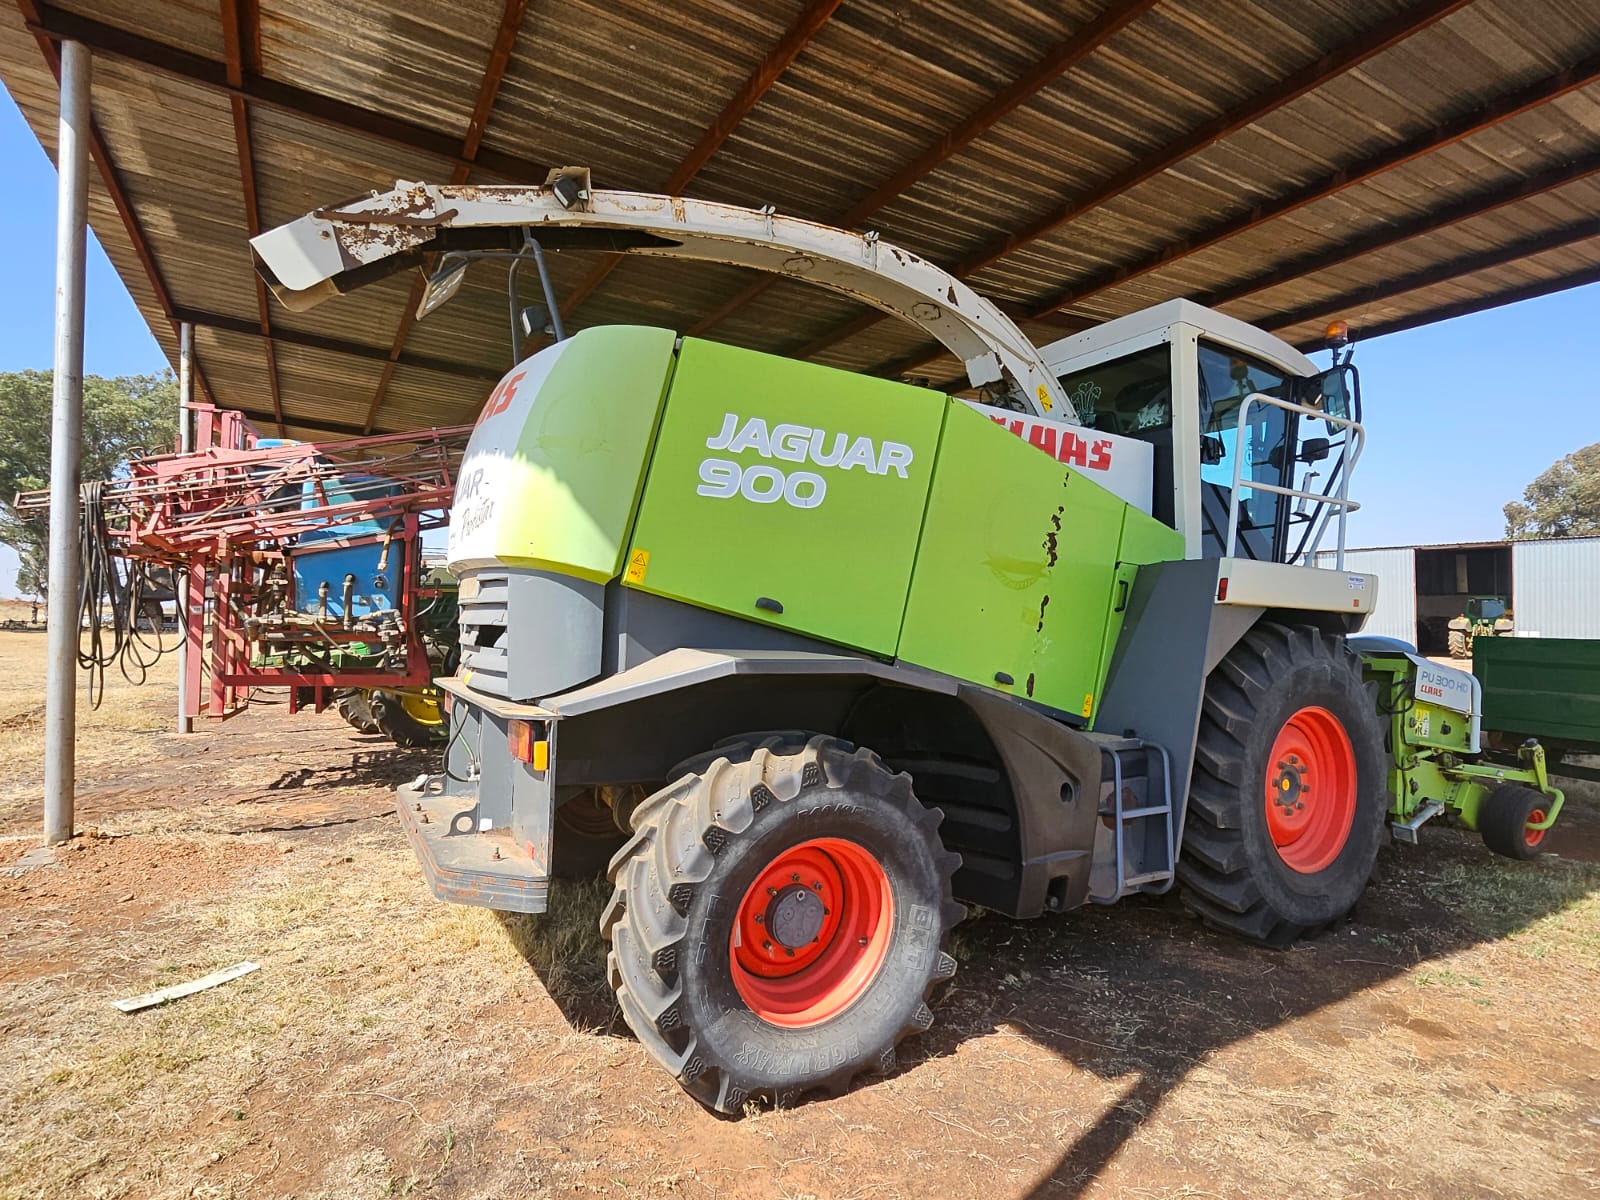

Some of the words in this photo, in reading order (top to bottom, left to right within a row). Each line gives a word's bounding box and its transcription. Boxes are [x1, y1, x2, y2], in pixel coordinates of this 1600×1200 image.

[706, 413, 914, 479] JAGUAR
[989, 414, 1113, 472] AAS
[696, 458, 827, 509] 900
[1420, 684, 1443, 697] CLAAS
[1421, 671, 1435, 683] PU
[1435, 675, 1455, 689] 300
[902, 904, 933, 972] BKT
